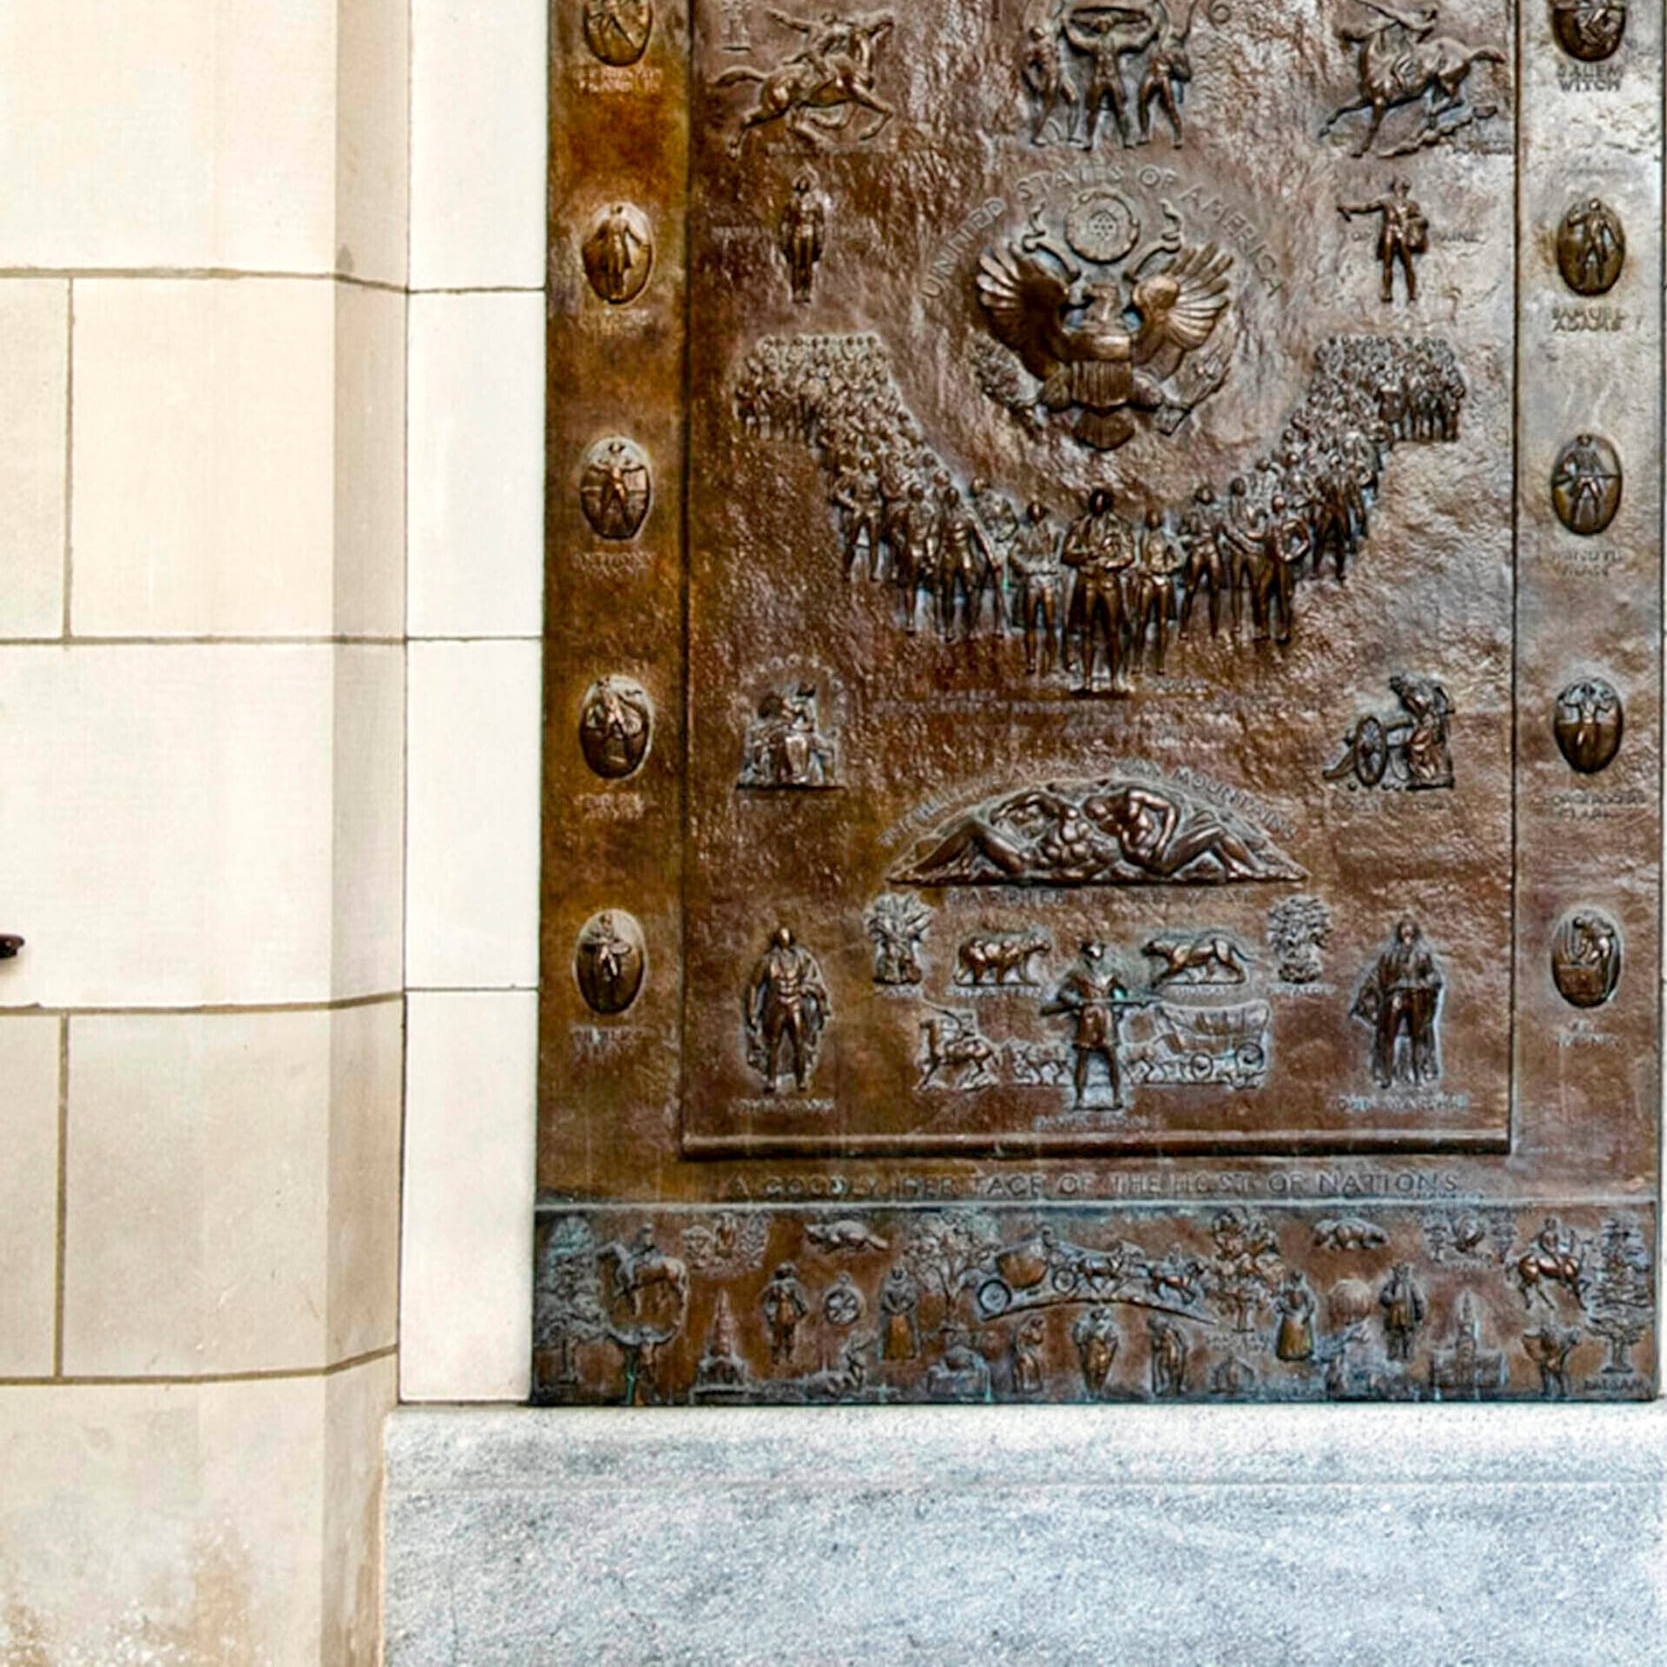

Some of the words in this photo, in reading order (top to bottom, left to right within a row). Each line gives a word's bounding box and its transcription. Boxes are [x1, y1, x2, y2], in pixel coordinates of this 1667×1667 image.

[1016, 165, 1125, 201] STATES
[1138, 165, 1180, 188] OF
[922, 197, 1006, 298] UNITED
[1181, 187, 1283, 297] AMERICA
[1267, 1172, 1302, 1195] OF
[1317, 1170, 1460, 1195] NATIONS
